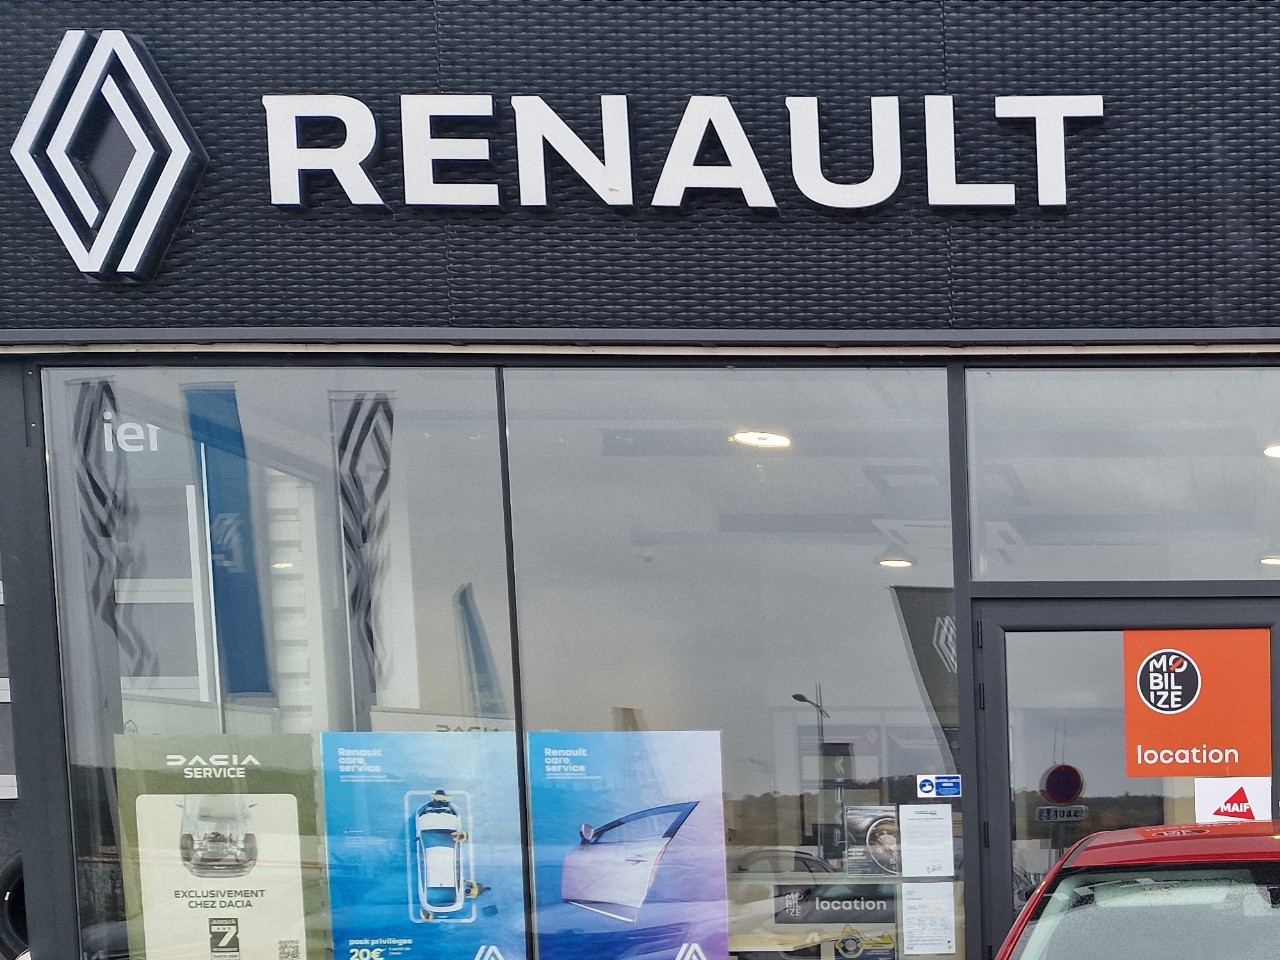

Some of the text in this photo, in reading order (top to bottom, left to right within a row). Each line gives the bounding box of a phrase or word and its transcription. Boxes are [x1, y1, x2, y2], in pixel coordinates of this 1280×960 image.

[262, 93, 1105, 208] RENAULT
[338, 748, 383, 756] Renault
[544, 748, 588, 756] Renault
[1137, 744, 1239, 765] location
[166, 754, 261, 766] DACIA
[184, 767, 246, 779] SERVICE
[339, 764, 382, 772] service
[545, 764, 586, 772] service
[1220, 802, 1251, 813] MAIF
[174, 889, 266, 899] EXCLUSIVEMENT
[188, 899, 253, 908] CHEZ DACIA
[815, 897, 887, 911] location
[211, 926, 237, 947] 7
[371, 938, 413, 946] privilèges
